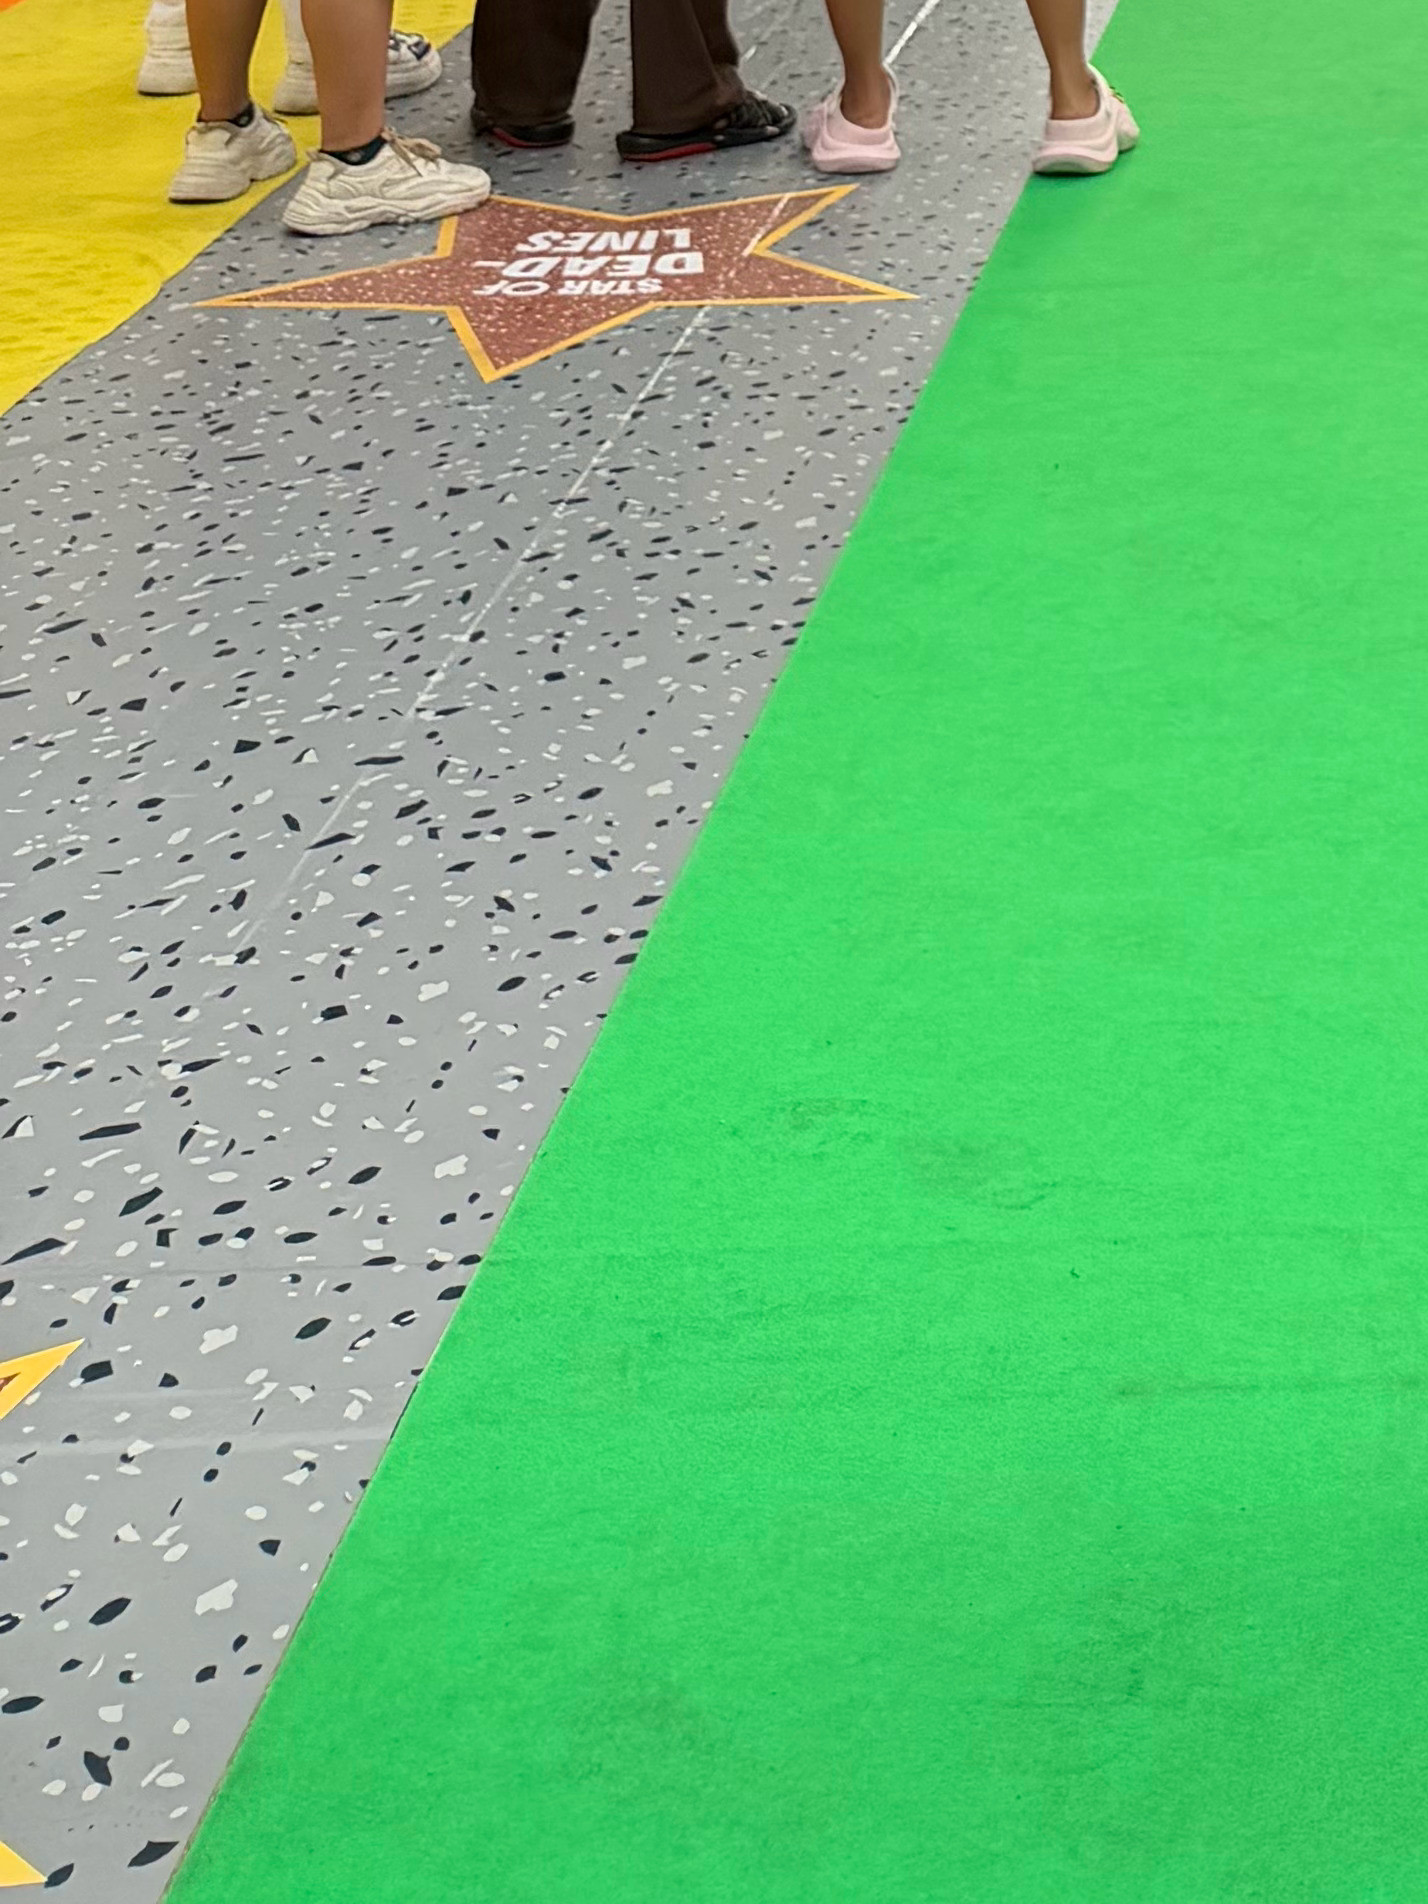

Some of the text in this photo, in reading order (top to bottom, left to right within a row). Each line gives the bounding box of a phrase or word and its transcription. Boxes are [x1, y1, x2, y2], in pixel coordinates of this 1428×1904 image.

[515, 228, 692, 253] LINES
[472, 277, 664, 297] STAR OF
